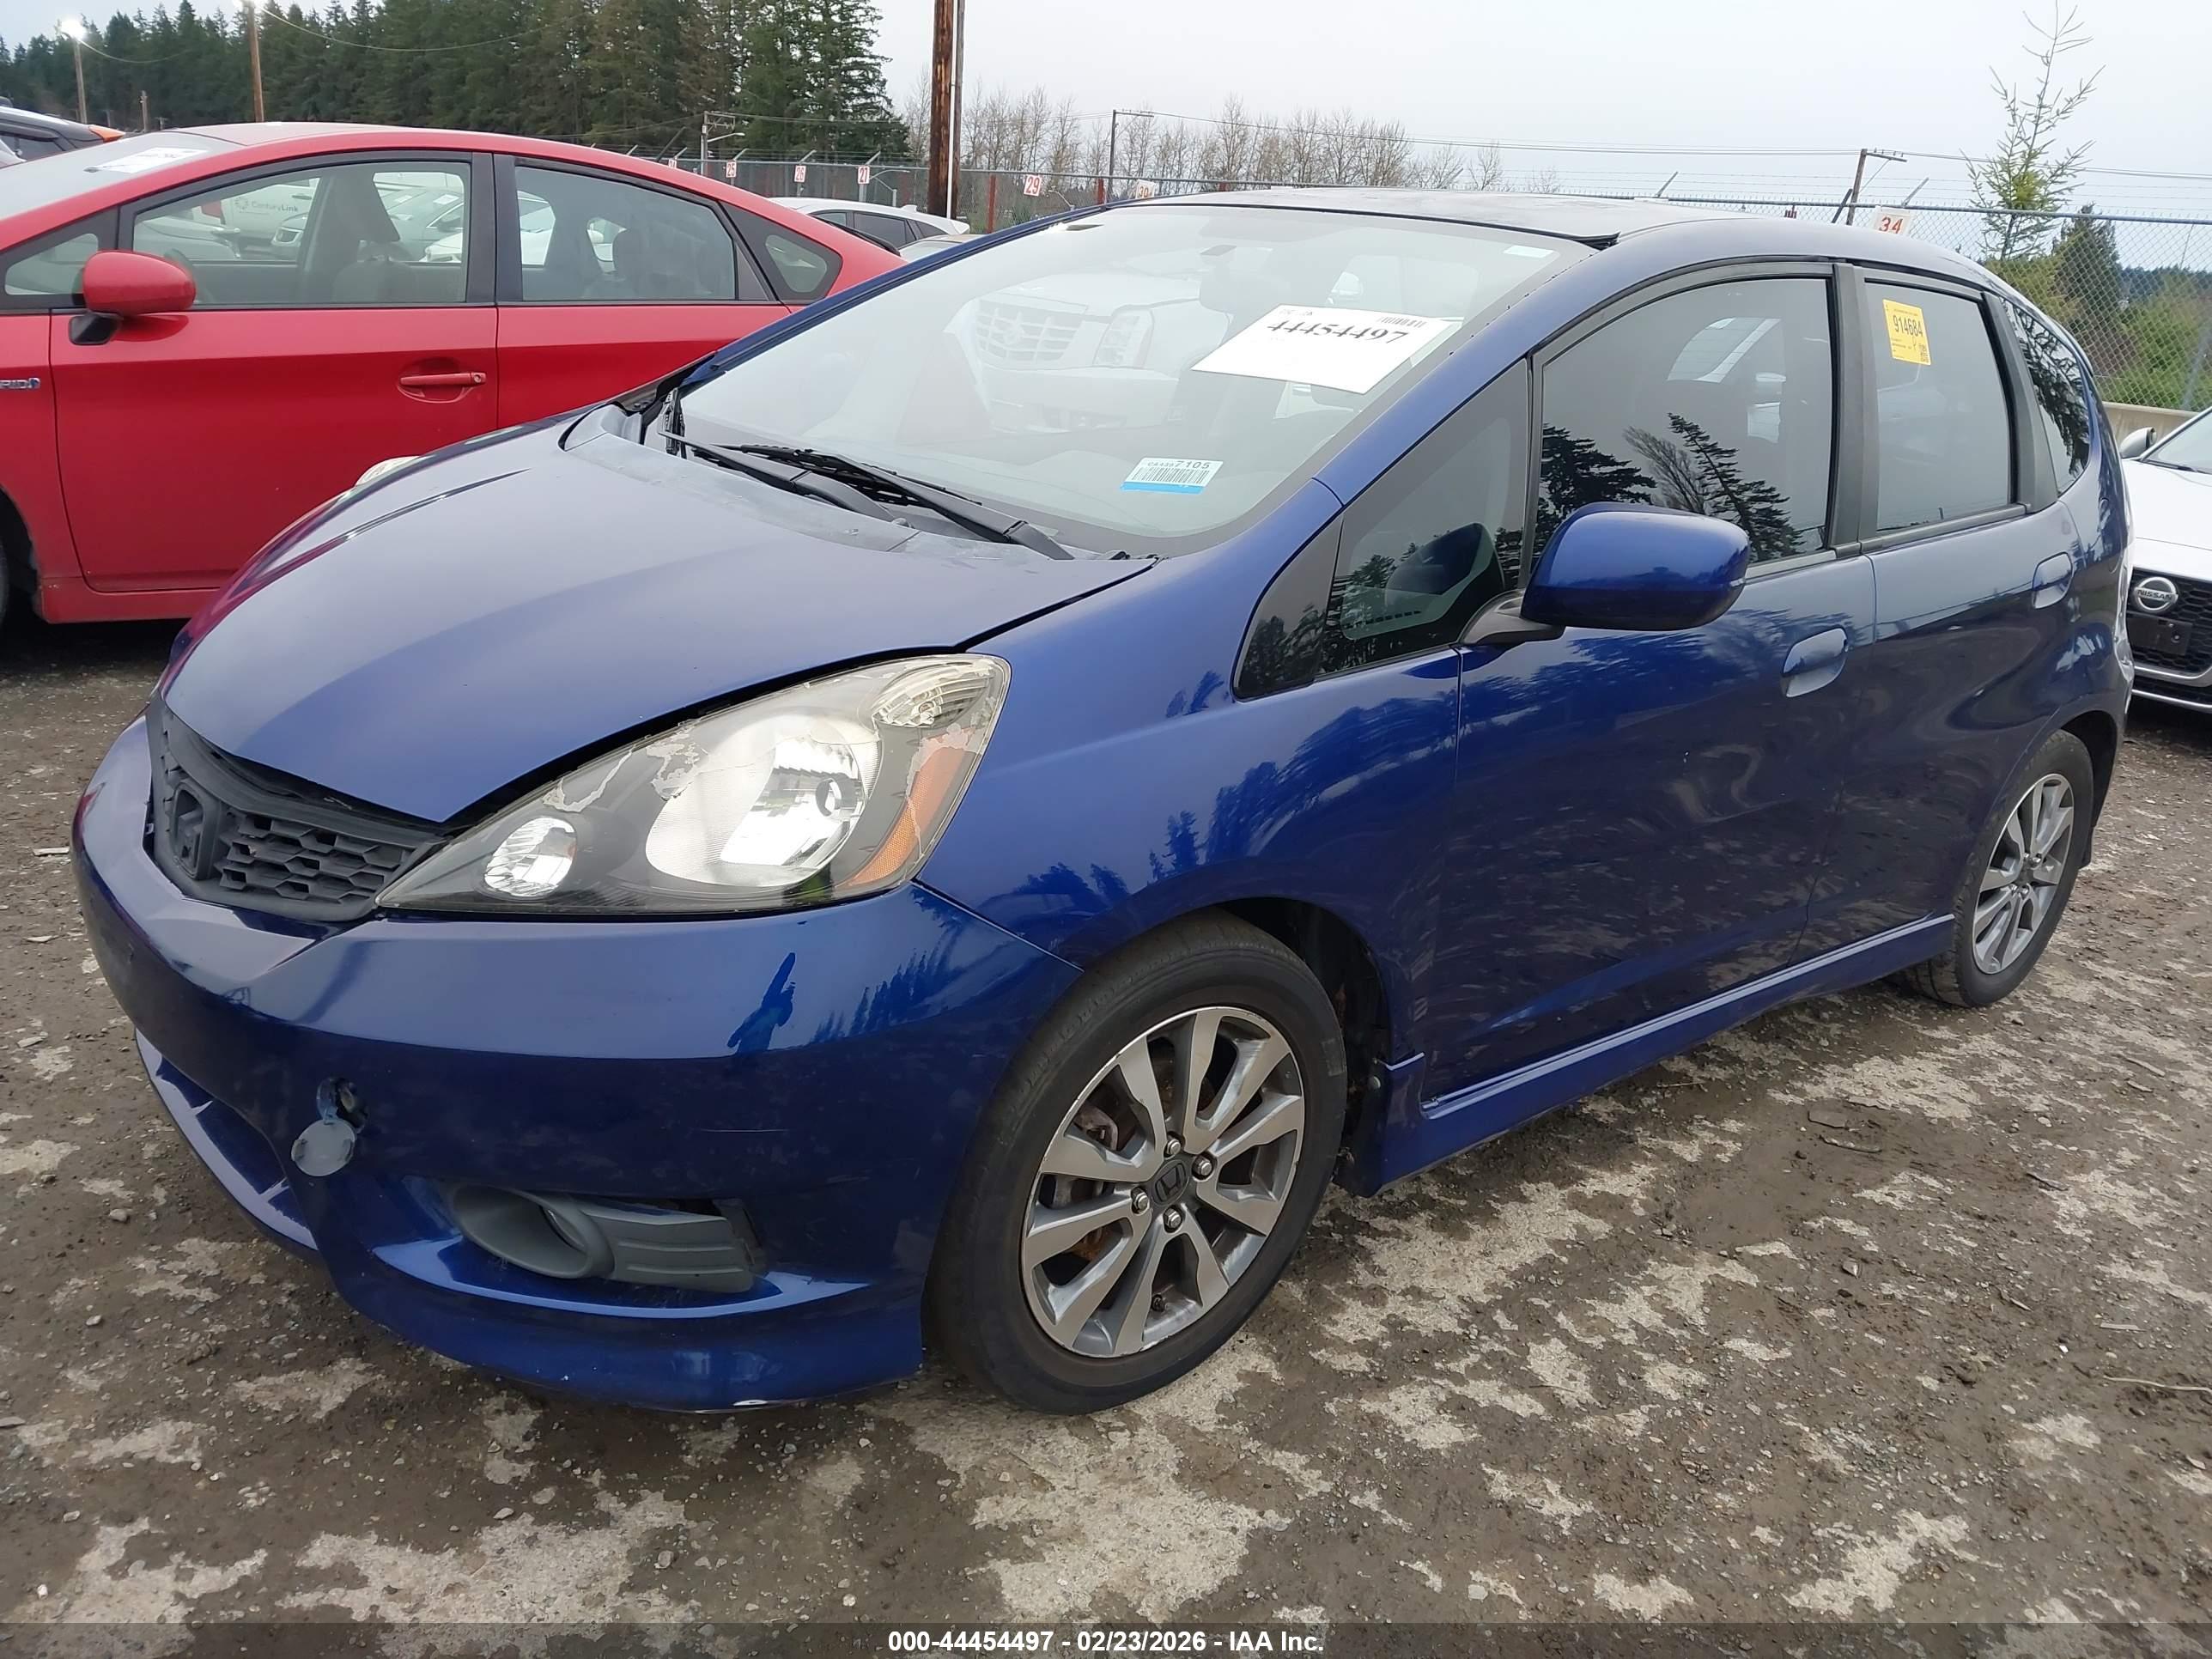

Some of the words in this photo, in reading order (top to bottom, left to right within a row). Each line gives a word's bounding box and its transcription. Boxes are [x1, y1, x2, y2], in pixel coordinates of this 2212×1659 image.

[727, 162, 735, 177] 25
[796, 167, 805, 181] 26
[860, 167, 869, 183] 27
[1026, 177, 1041, 194] 29
[1878, 216, 1904, 234] 34
[1267, 319, 1410, 344] 44454497
[1893, 314, 1923, 337] 914684
[2137, 589, 2172, 600] NISSAN
